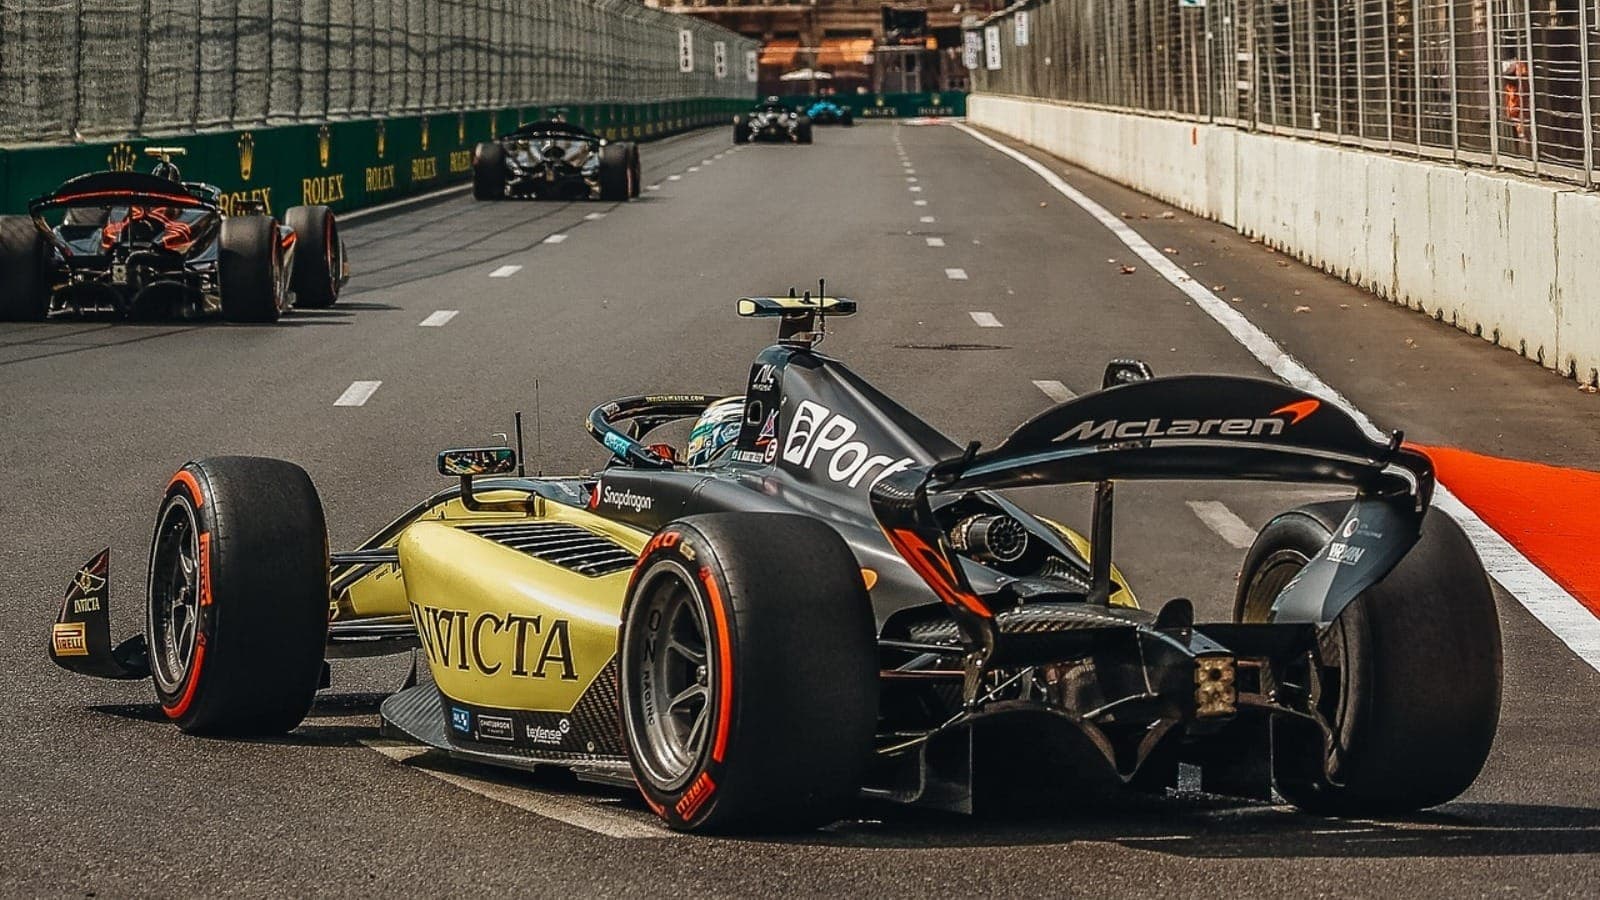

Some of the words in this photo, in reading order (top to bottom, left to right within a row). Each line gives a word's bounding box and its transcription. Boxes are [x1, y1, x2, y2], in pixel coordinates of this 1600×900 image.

[303, 174, 343, 206] ROLEX
[365, 165, 394, 192] ROLEX
[1052, 418, 1285, 442] McLaren
[603, 485, 652, 512] Snapdragon
[74, 597, 101, 614] INVICTA
[55, 629, 84, 651] PIRELLI
[409, 601, 579, 681] NVICTA
[642, 670, 656, 726] RACING
[675, 771, 716, 821] PIRELLI
